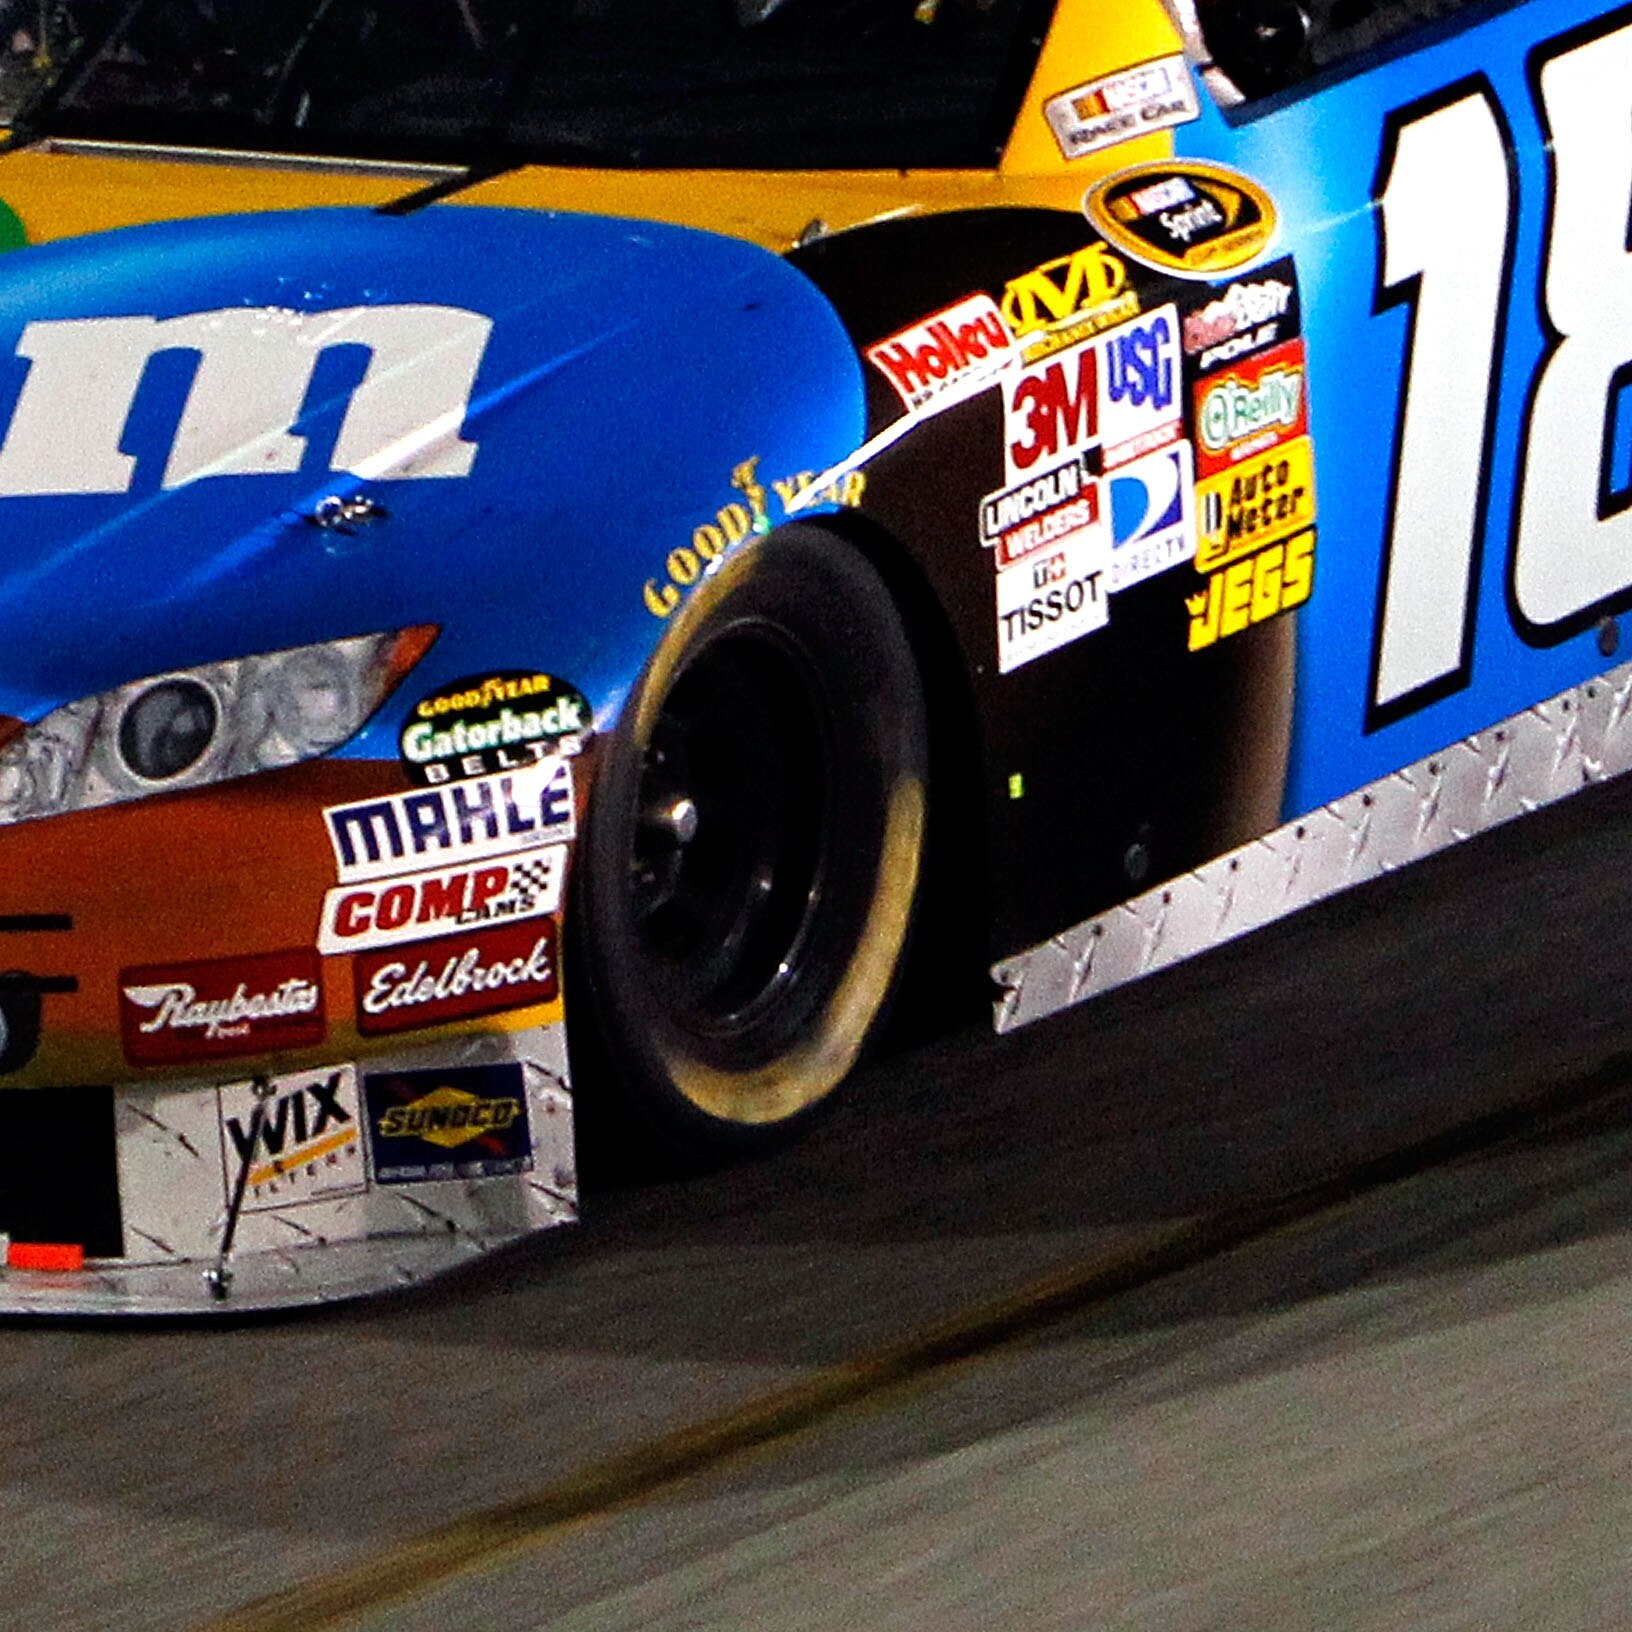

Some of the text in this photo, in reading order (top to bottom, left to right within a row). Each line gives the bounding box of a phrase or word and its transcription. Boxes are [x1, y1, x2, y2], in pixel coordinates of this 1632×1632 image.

[1158, 199, 1224, 242] Sprint
[1105, 317, 1173, 411] USG
[1009, 346, 1099, 470] 3M
[985, 464, 1081, 540] LINCOLN
[1005, 499, 1090, 558] WELDERS
[999, 569, 1103, 643] TISSOT
[1188, 529, 1314, 652] JEGS
[403, 696, 583, 764] Gatorback
[423, 734, 583, 784] BELTS
[329, 765, 569, 868] MAHLE
[333, 865, 510, 939] COMP
[455, 895, 536, 925] CAMS
[362, 937, 552, 1015] Edelbrock
[225, 1072, 353, 1155] WIX
[380, 1100, 515, 1134] SUNOCO
